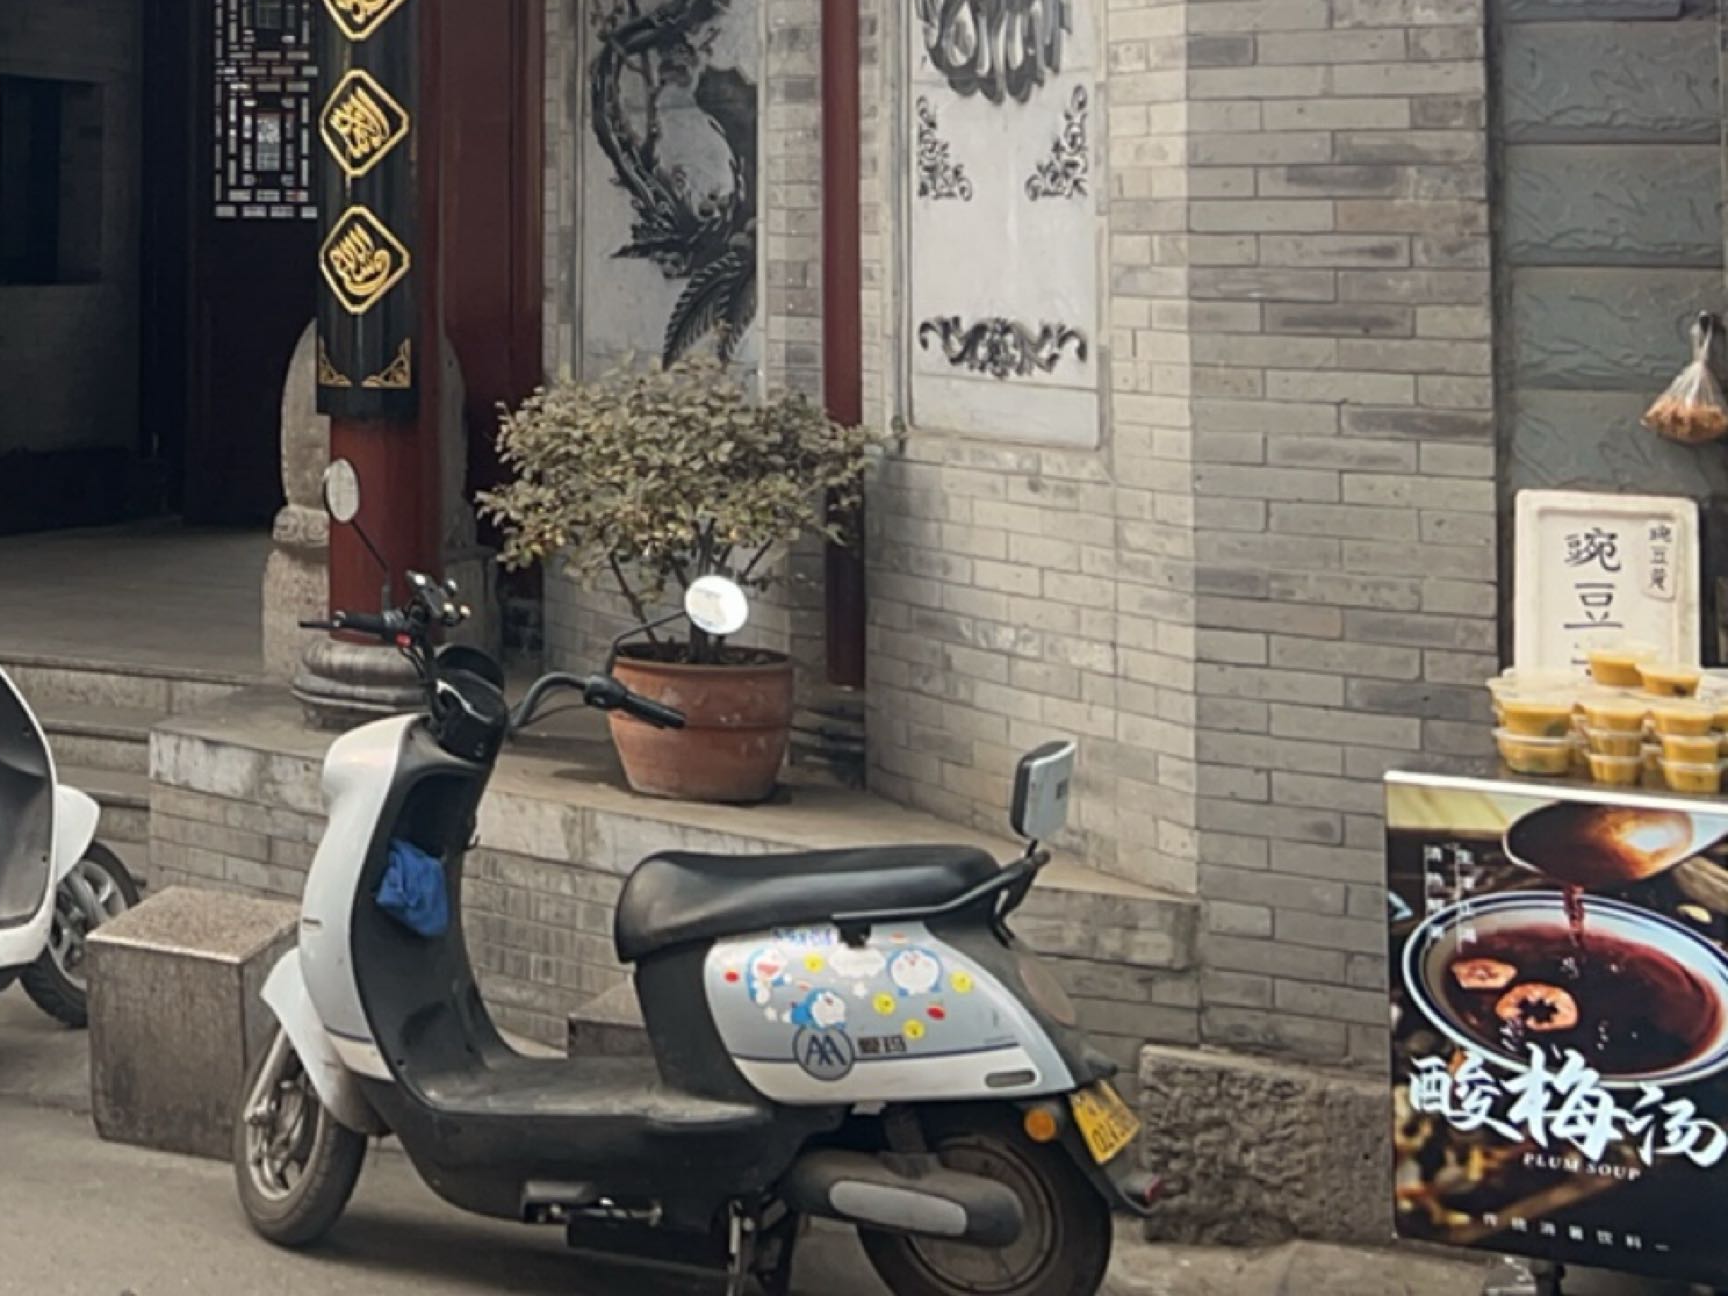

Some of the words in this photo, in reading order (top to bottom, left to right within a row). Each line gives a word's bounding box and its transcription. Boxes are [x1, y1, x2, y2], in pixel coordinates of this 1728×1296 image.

[1563, 527, 1623, 677] 豌豆
[1409, 1042, 1728, 1168] 酸梅汤
[1523, 1151, 1580, 1173] PLUM
[1585, 1162, 1642, 1182] SOUP
